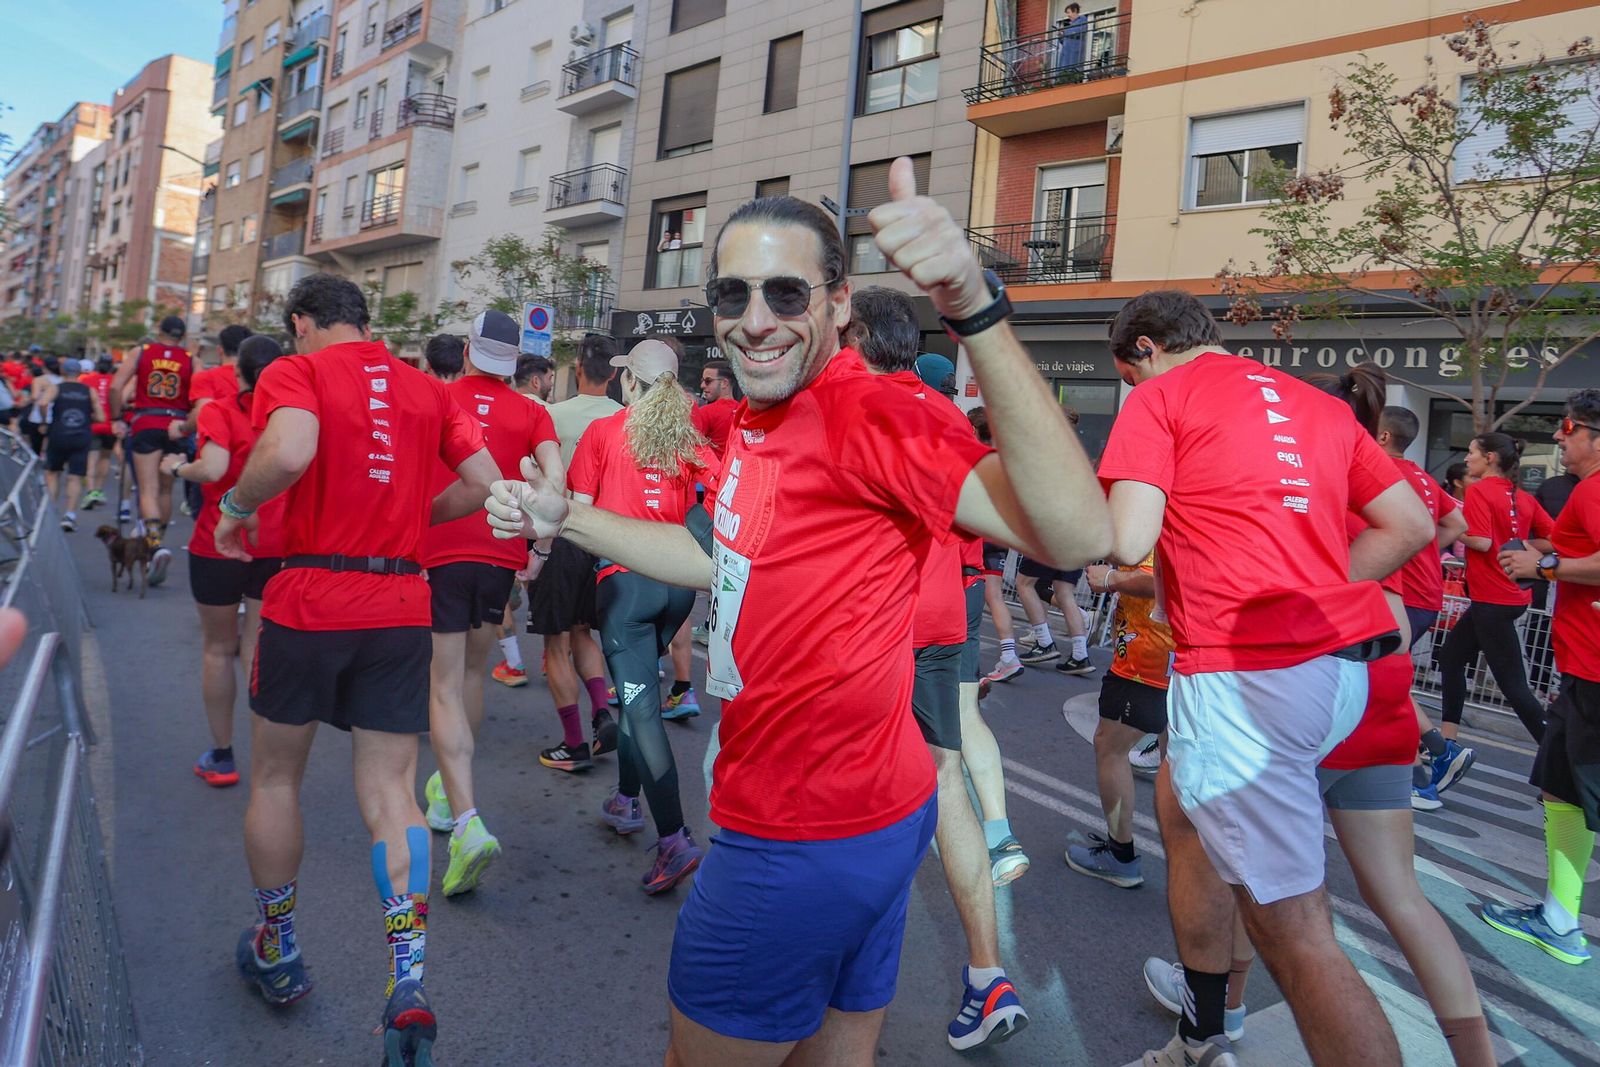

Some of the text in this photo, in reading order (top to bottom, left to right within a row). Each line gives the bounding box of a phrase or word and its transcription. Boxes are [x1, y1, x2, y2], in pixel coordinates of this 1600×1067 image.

[1052, 361, 1064, 371] de
[1066, 361, 1095, 374] viajes
[147, 370, 181, 399] 23
[624, 683, 647, 706] adidas
